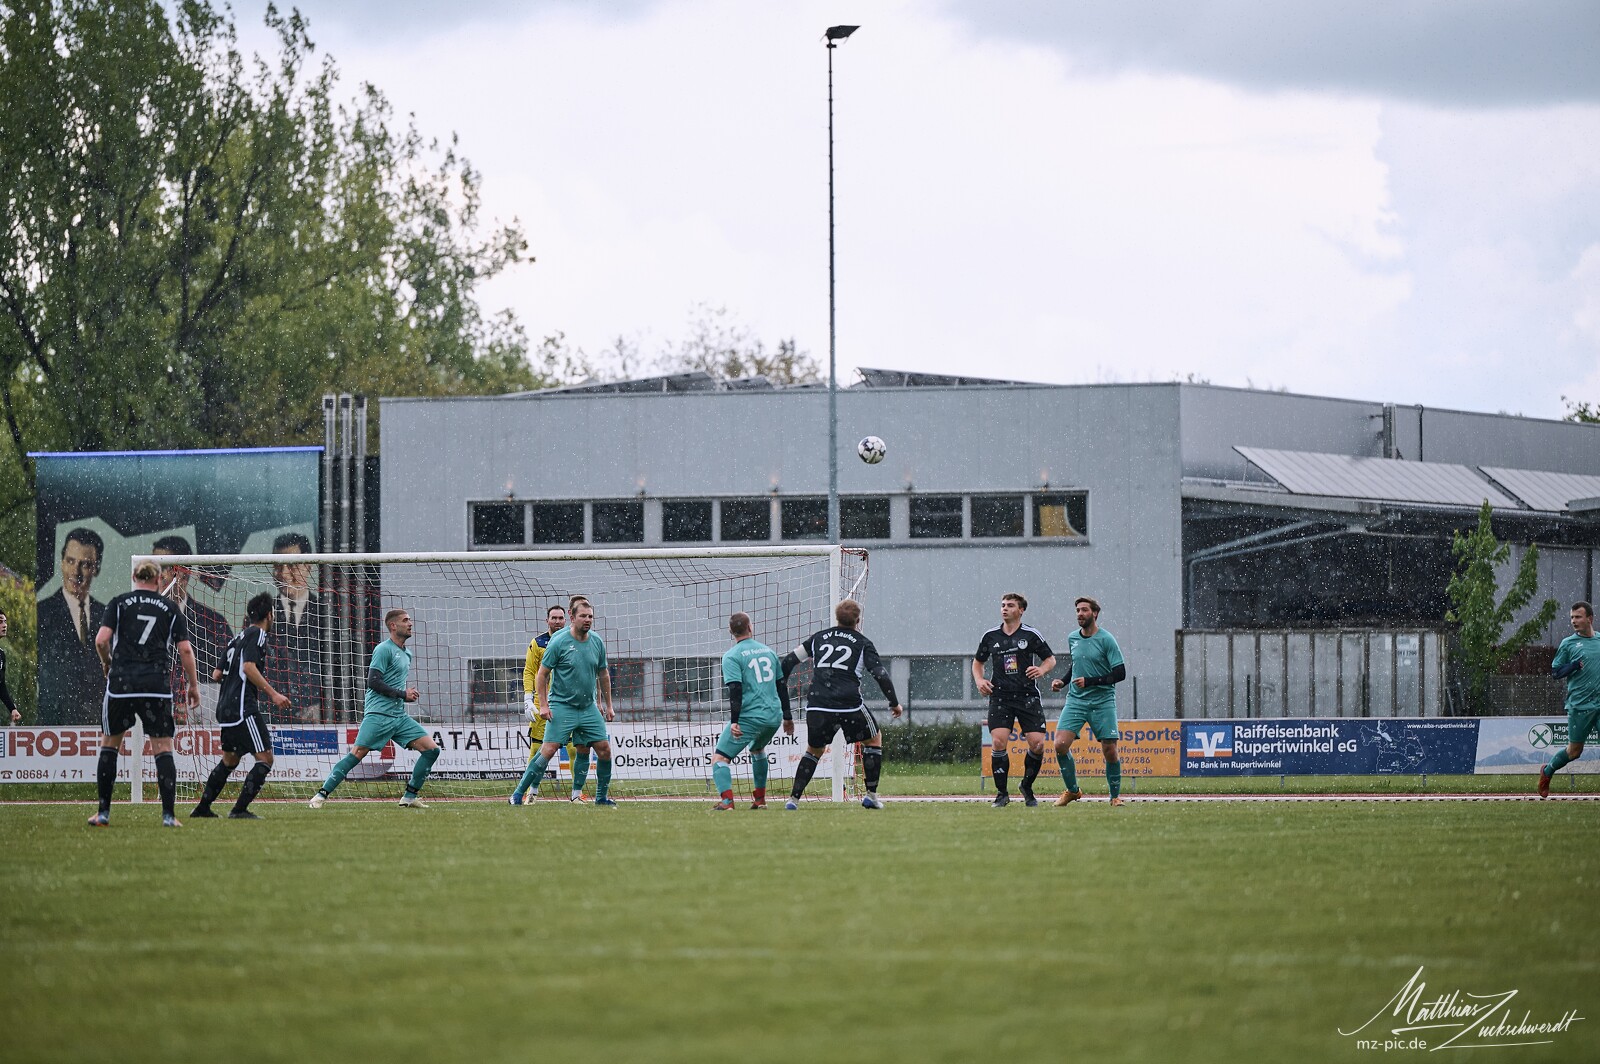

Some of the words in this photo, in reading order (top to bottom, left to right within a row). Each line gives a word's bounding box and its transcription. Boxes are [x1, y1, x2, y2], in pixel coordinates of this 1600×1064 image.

[125, 595, 138, 607] SV
[139, 595, 169, 612] Laufen
[137, 614, 157, 645] 7
[822, 631, 833, 640] SV
[834, 630, 858, 644] Laufen
[817, 643, 853, 670] 22
[748, 656, 774, 683] 13
[1234, 725, 1339, 739] Raiffeisenbank
[615, 735, 688, 748] Volksbank
[1234, 740, 1333, 756] Rupertiwinkel
[1338, 740, 1357, 753] eG
[614, 755, 700, 770] Oberbayern
[1186, 761, 1199, 769] Die
[1200, 761, 1218, 769] Bank
[1231, 761, 1282, 770] Rupertiwinkel
[16, 769, 49, 779] 08684
[71, 769, 83, 779] 71
[305, 768, 318, 777] 22
